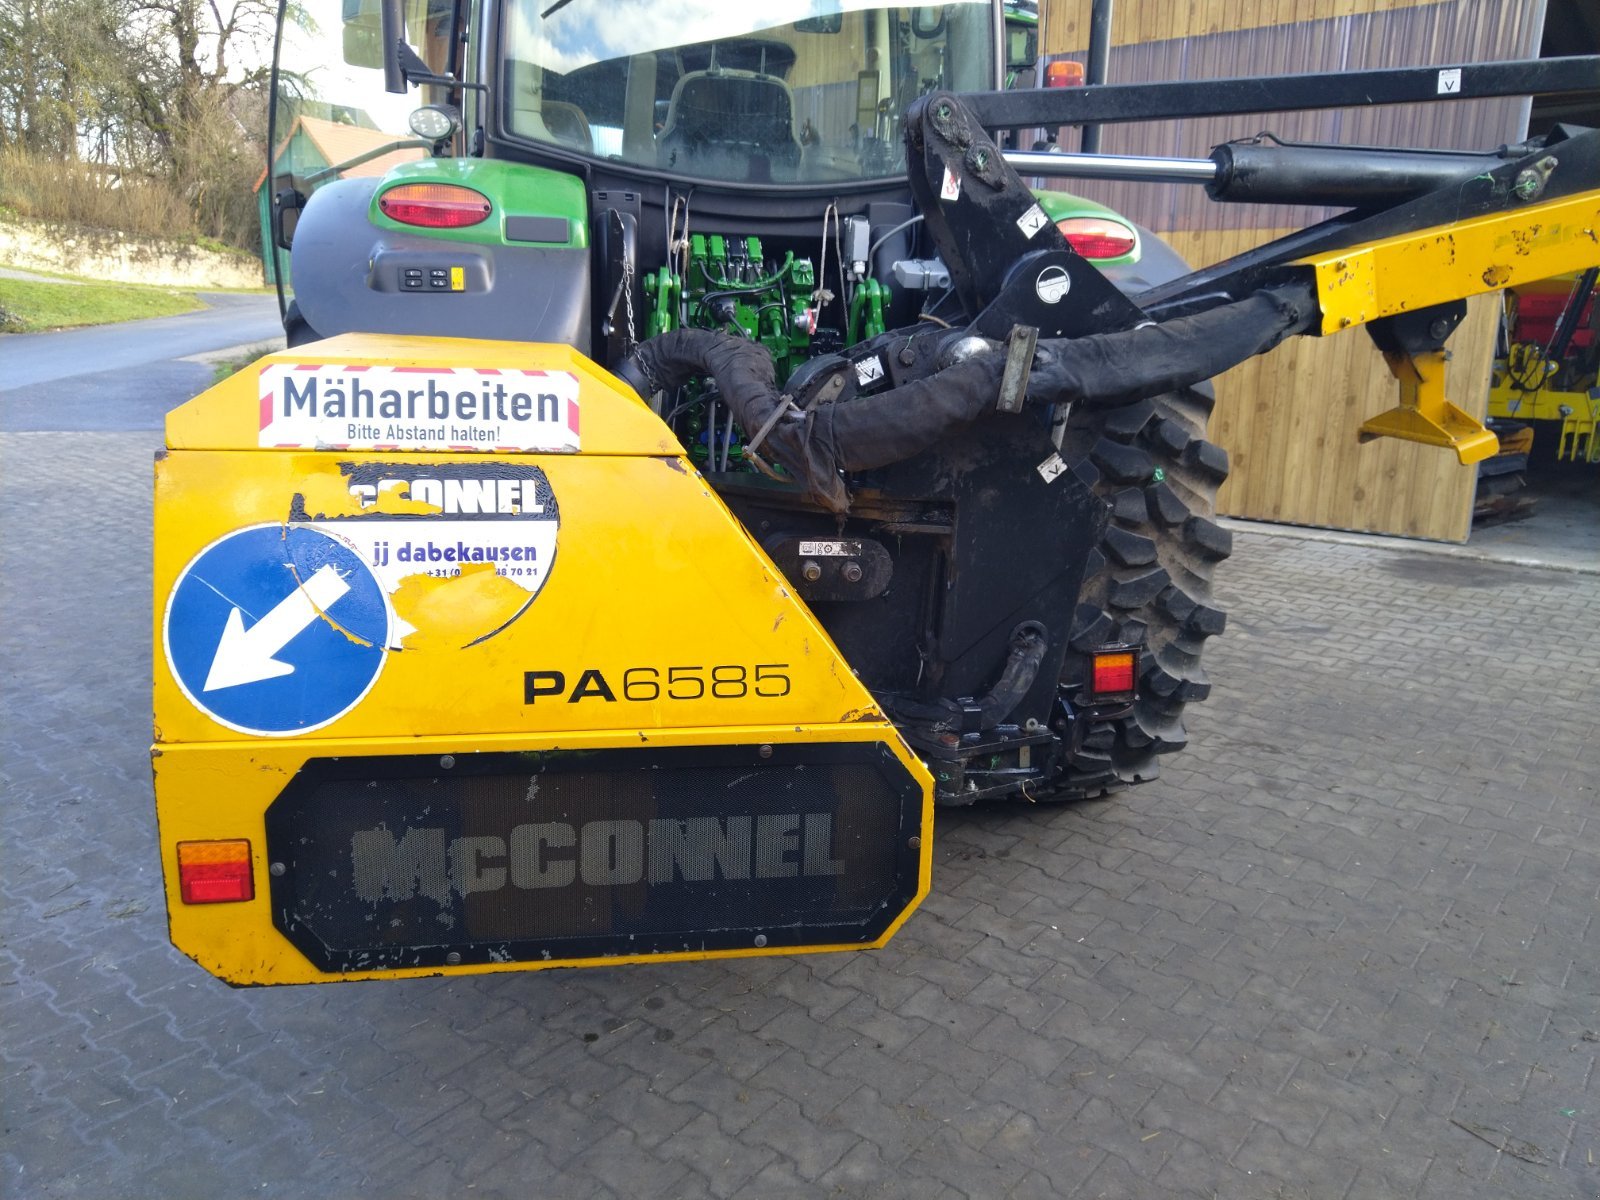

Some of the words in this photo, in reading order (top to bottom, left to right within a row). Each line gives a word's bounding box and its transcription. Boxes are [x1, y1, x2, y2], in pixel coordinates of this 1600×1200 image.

[283, 376, 559, 422] Mäharbeiten
[347, 423, 381, 440] Bitte
[386, 424, 445, 441] Abstand
[450, 425, 501, 442] halten!
[372, 541, 389, 567] jj
[396, 541, 537, 562] dabekausen
[510, 567, 523, 576] 70
[526, 567, 538, 576] 21
[523, 663, 791, 705] PA6585
